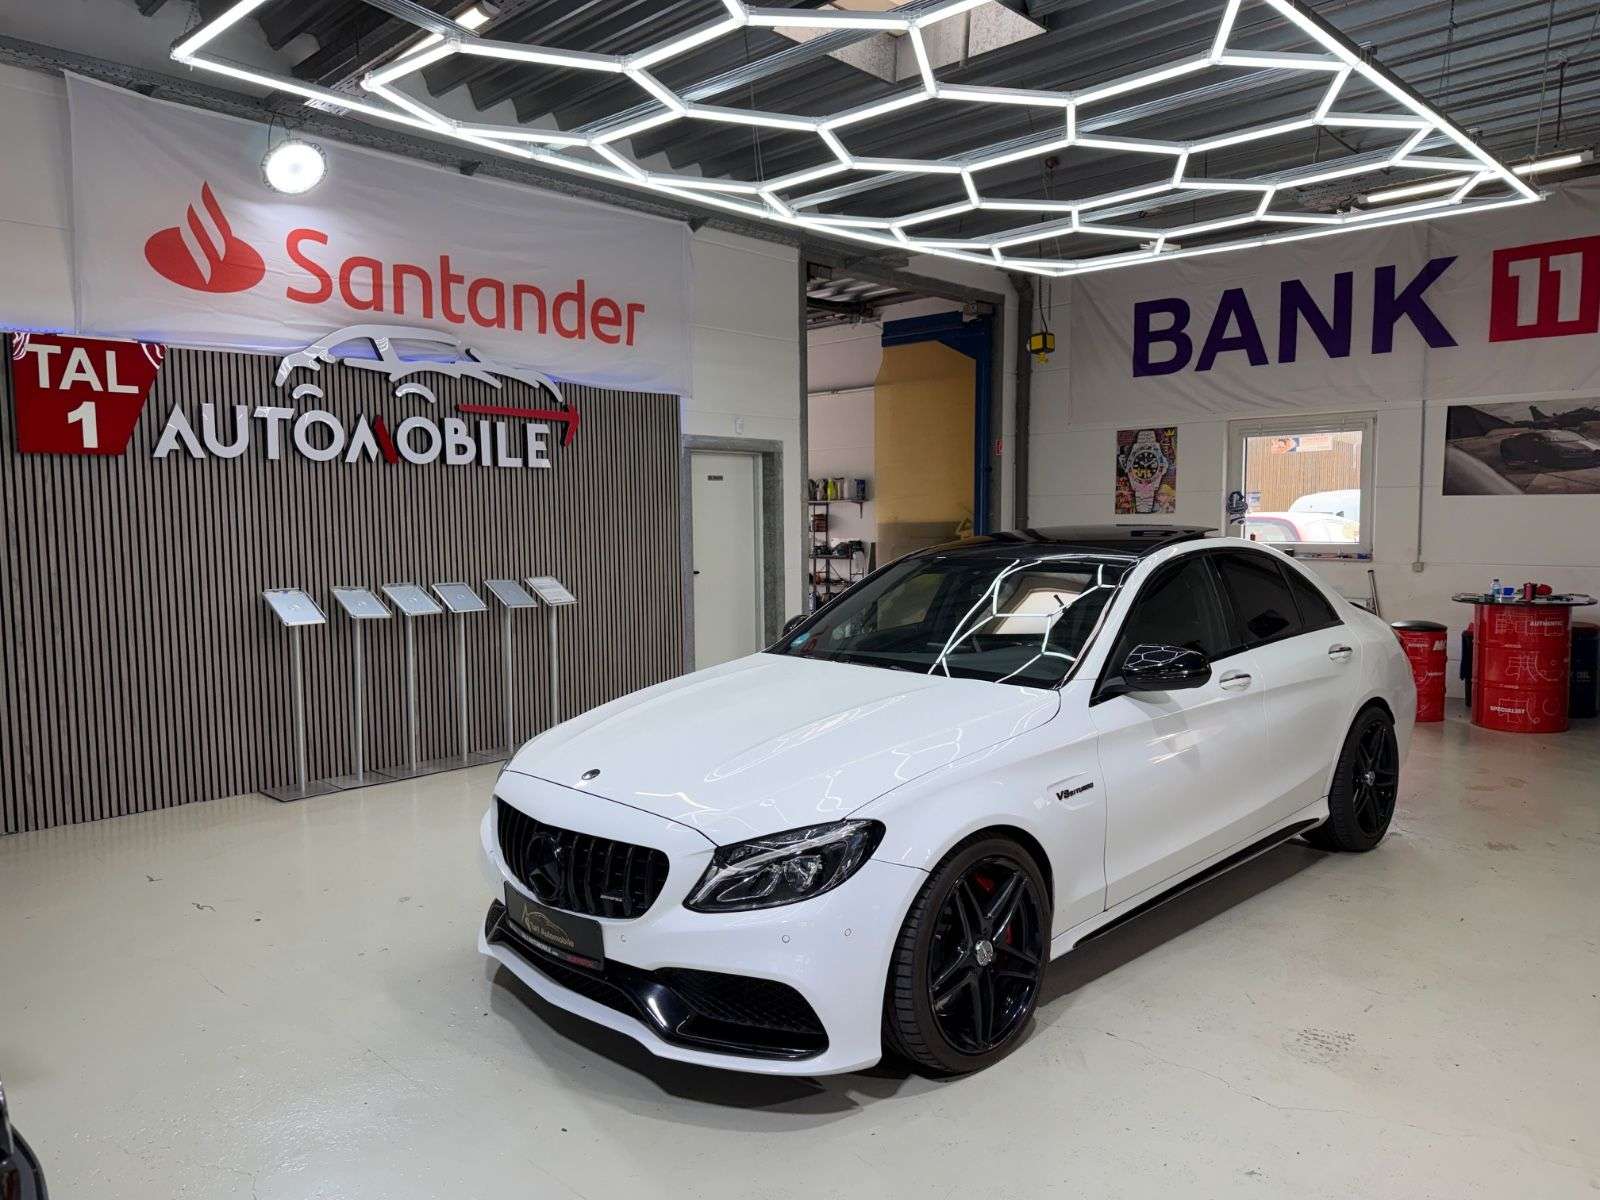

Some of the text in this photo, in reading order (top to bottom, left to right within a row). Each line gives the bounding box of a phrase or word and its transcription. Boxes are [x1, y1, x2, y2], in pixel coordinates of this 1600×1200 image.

[286, 229, 644, 346] Santander
[1133, 252, 1583, 377] BANK 11
[25, 343, 140, 394] TAL
[67, 401, 98, 448] 1
[153, 402, 552, 469] AUTOMOBILE
